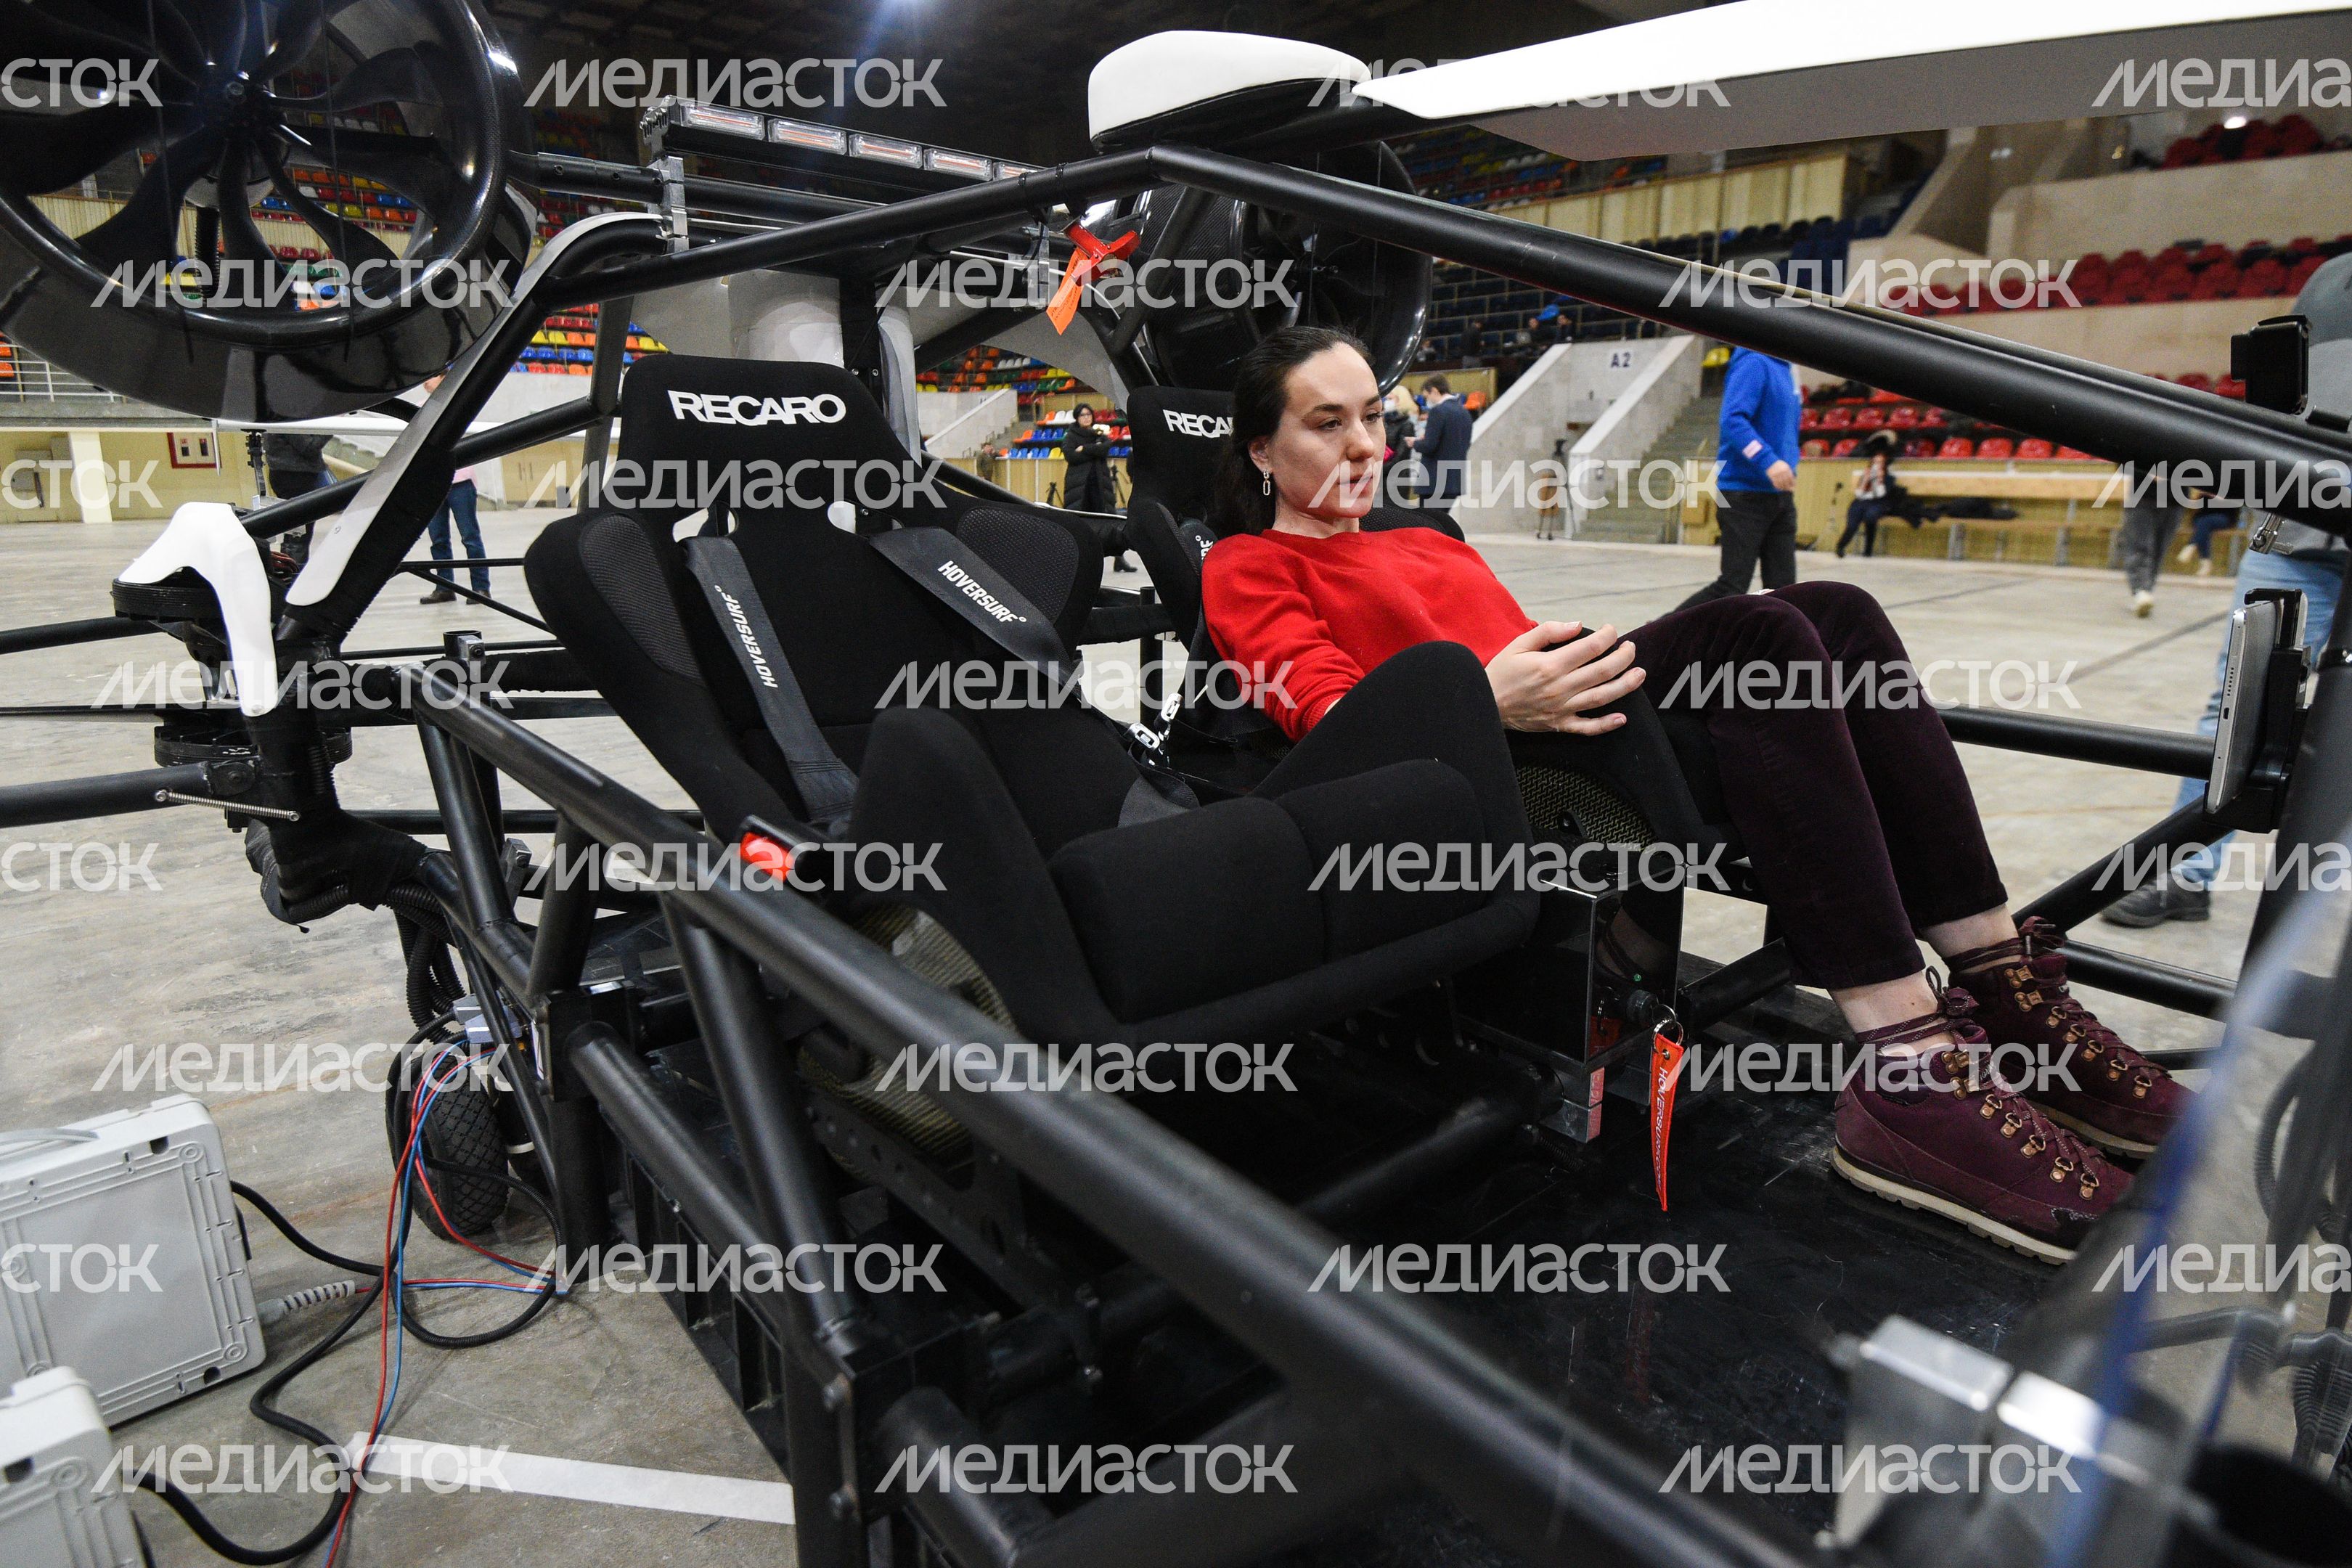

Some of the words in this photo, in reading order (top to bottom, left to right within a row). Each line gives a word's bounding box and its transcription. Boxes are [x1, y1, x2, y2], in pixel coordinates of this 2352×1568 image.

[1611, 352, 1630, 368] A2
[667, 390, 846, 426] RECARO
[1163, 409, 1234, 438] RECA
